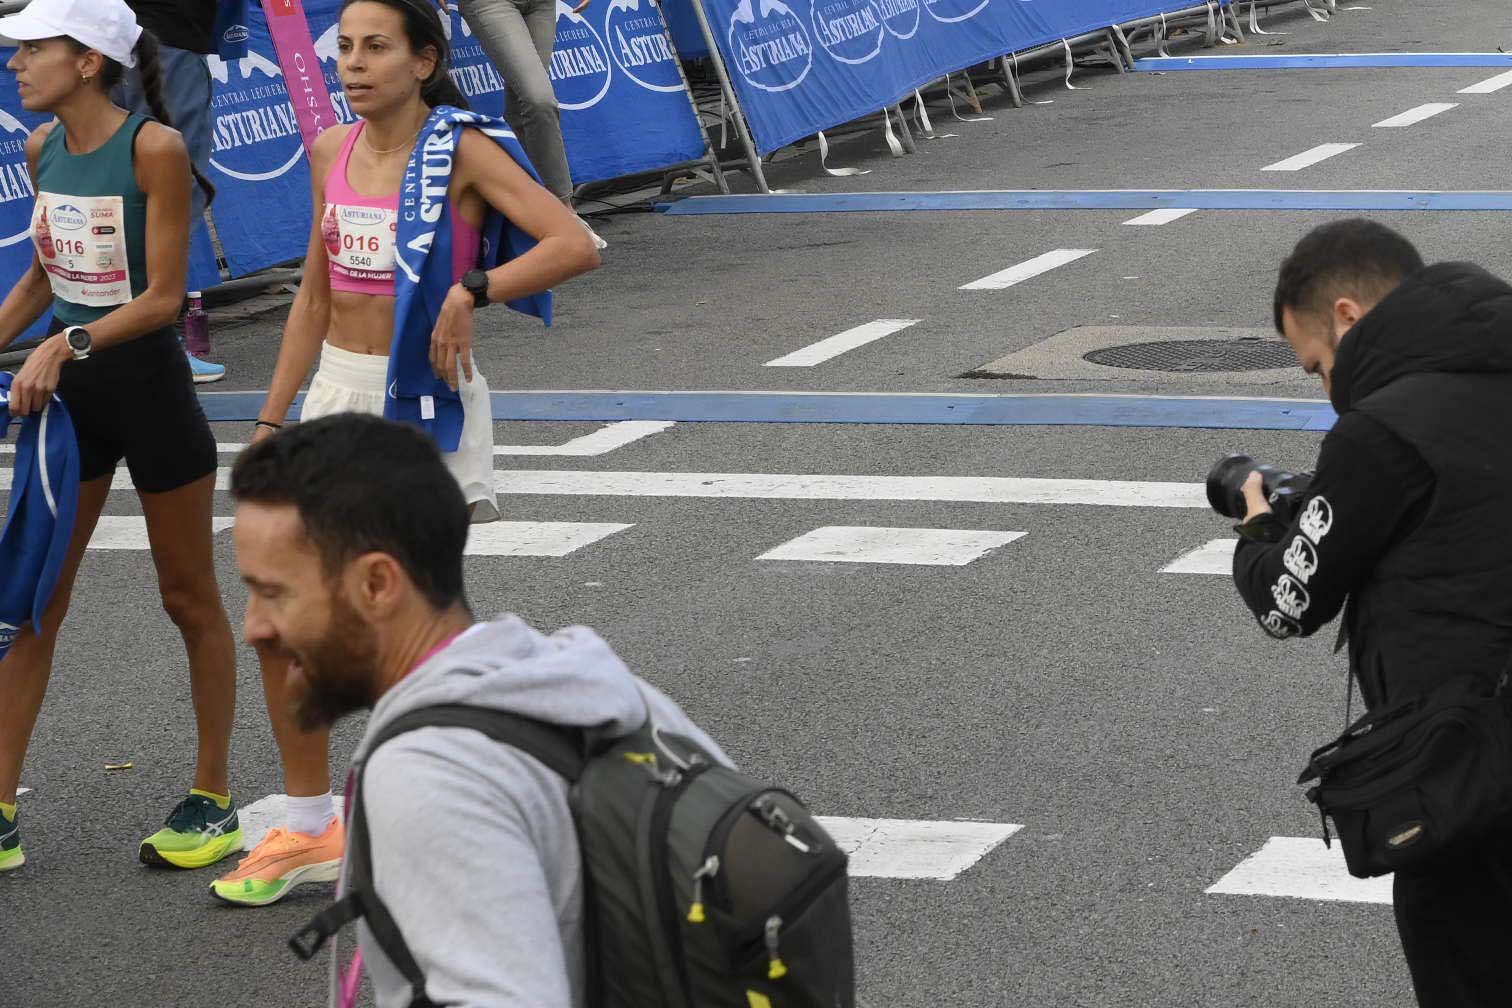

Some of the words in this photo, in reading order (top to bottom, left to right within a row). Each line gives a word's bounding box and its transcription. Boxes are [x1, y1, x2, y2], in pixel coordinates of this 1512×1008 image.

[55, 239, 84, 255] 016
[343, 234, 379, 252] 016
[350, 255, 372, 267] 5540
